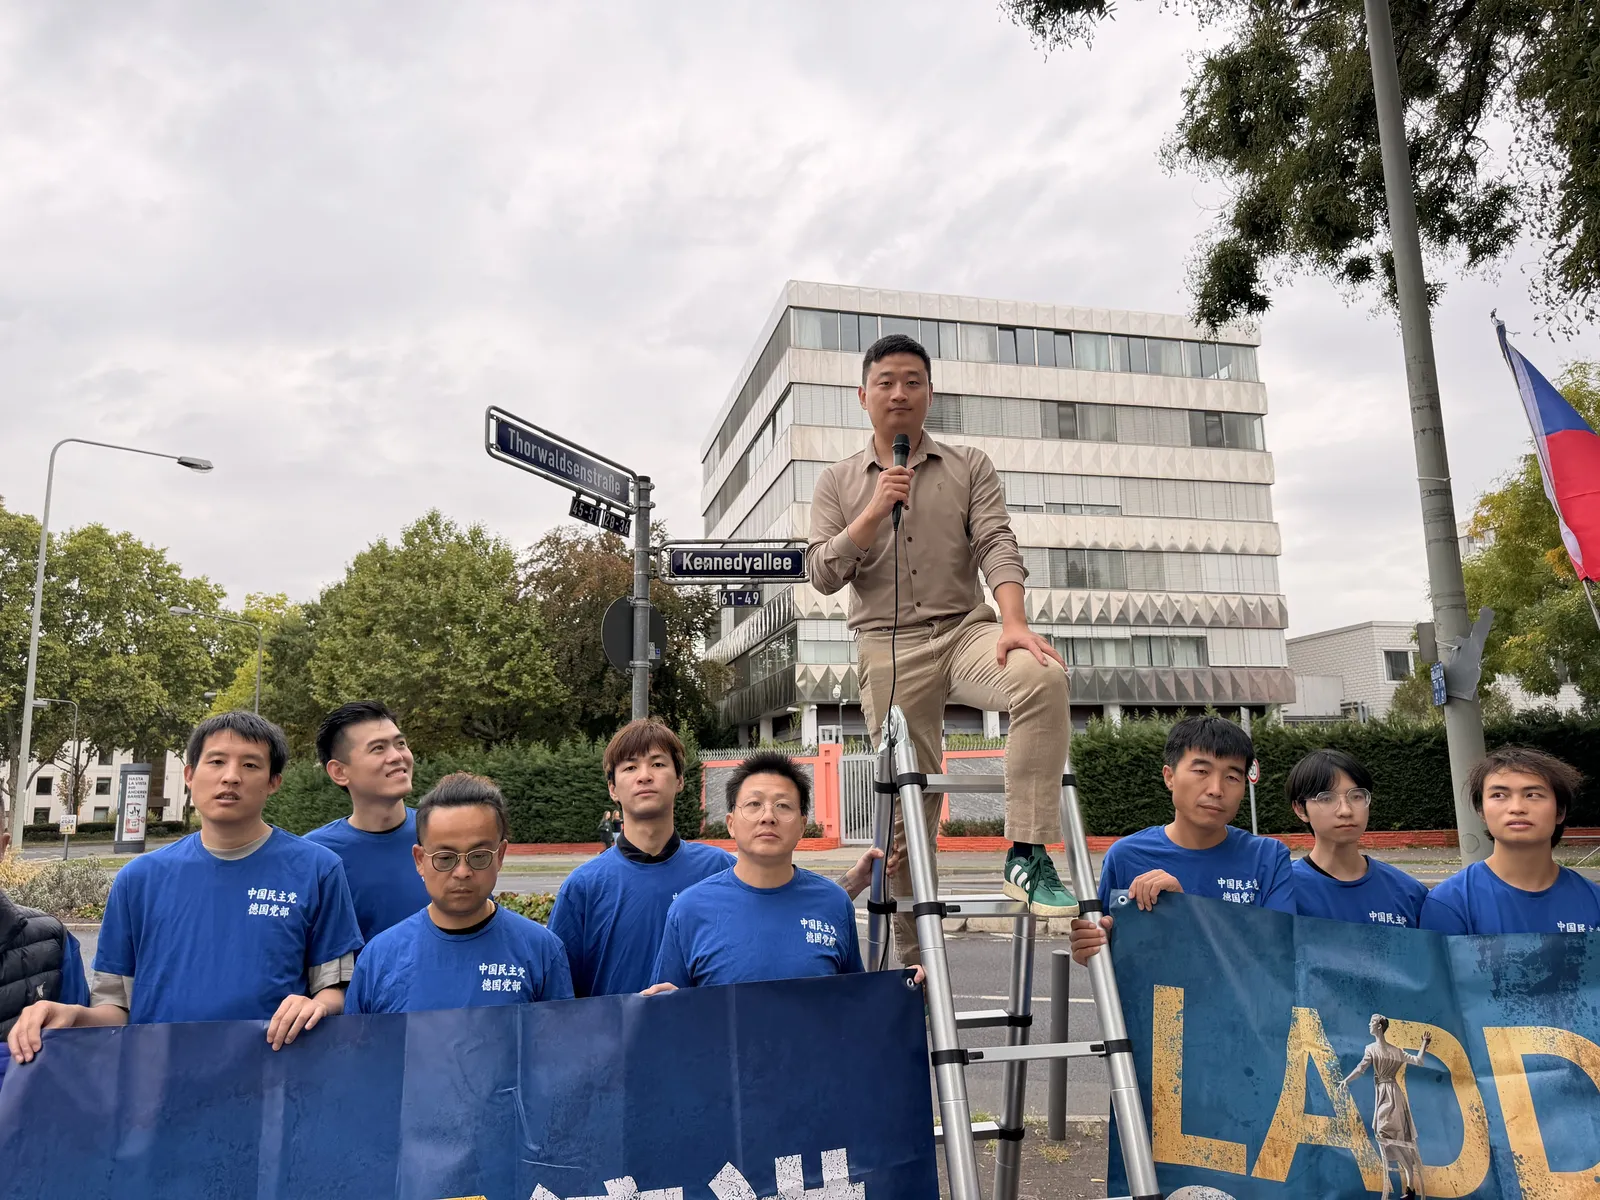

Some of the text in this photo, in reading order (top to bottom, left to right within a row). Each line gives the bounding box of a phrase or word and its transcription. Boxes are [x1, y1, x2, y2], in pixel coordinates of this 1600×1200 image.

[508, 428, 621, 496] Thorwaldsenstraße
[572, 501, 600, 523] 45-51
[604, 513, 630, 534] 28-36
[682, 552, 792, 574] Kennedyallee
[721, 591, 760, 605] 61-49
[247, 887, 298, 904] 中国民主党
[248, 902, 290, 919] 德国党部
[481, 978, 522, 994] 德国党部
